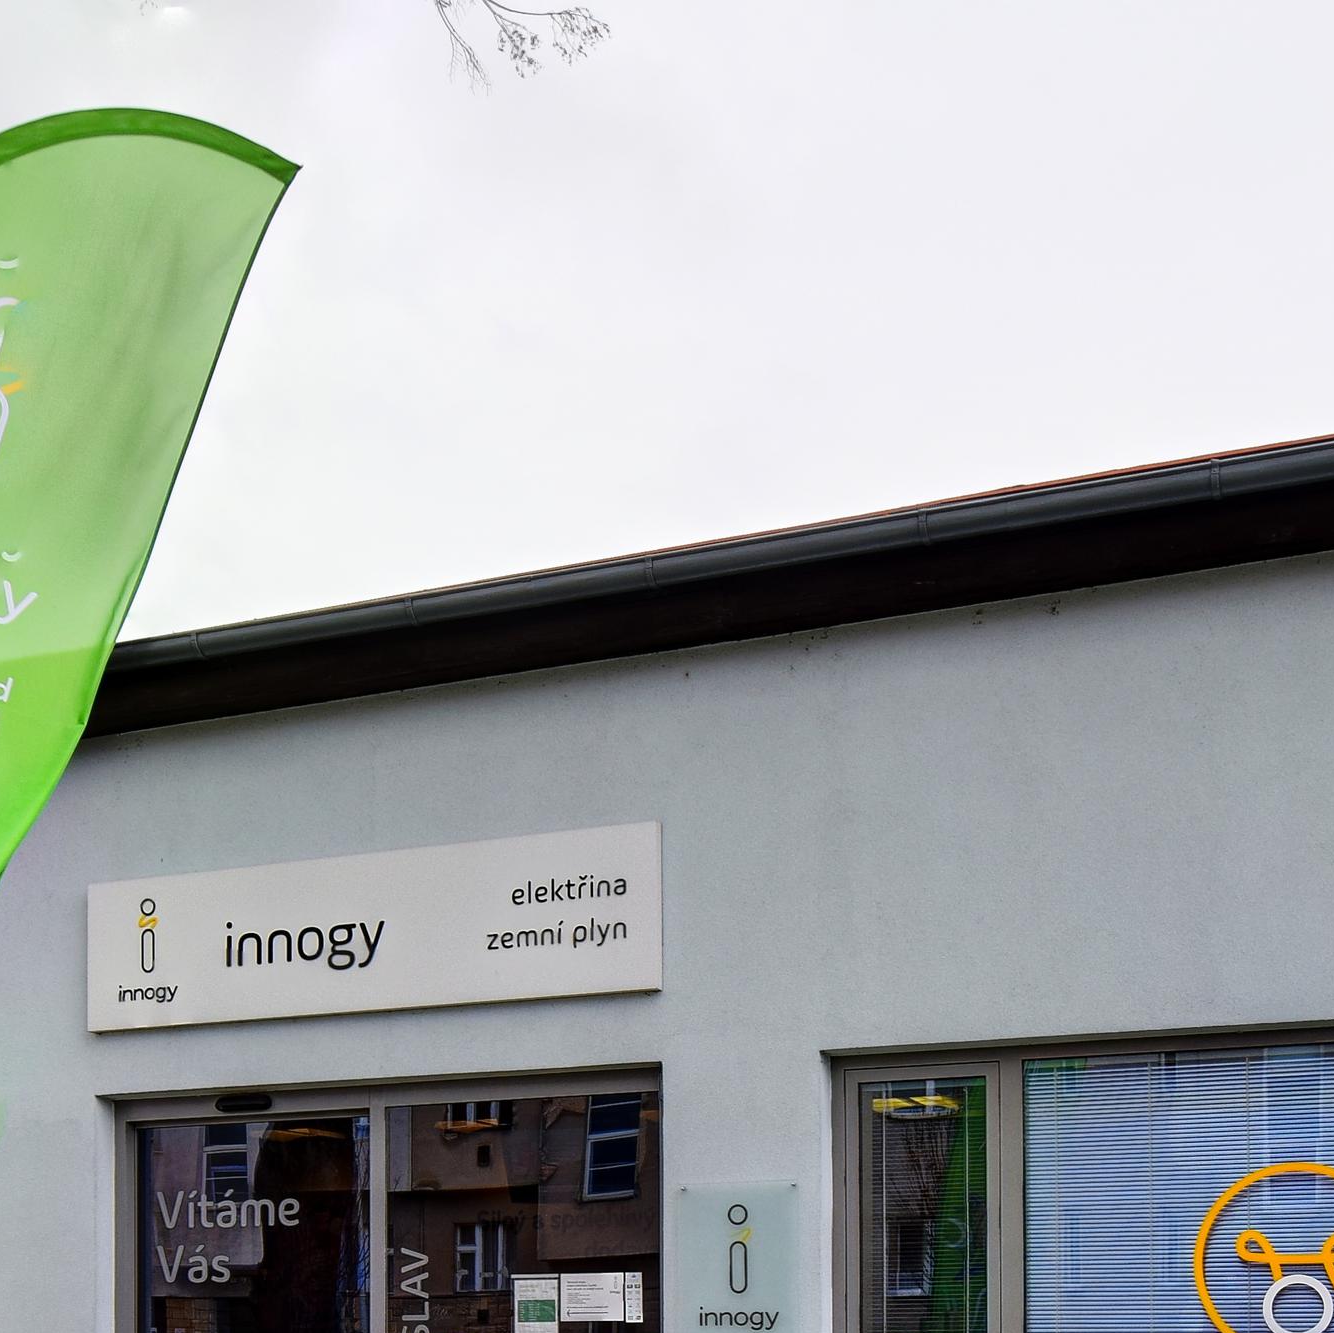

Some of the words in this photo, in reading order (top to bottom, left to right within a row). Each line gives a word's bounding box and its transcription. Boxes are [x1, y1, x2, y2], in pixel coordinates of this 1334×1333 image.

[511, 874, 627, 906] elektřina
[225, 919, 386, 971] innogy
[486, 920, 564, 950] zemní
[572, 917, 627, 949] plyn
[117, 984, 179, 1003] innogy
[156, 1188, 301, 1229] Vítáme
[156, 1244, 232, 1284] Vás
[699, 1306, 780, 1331] innogy
